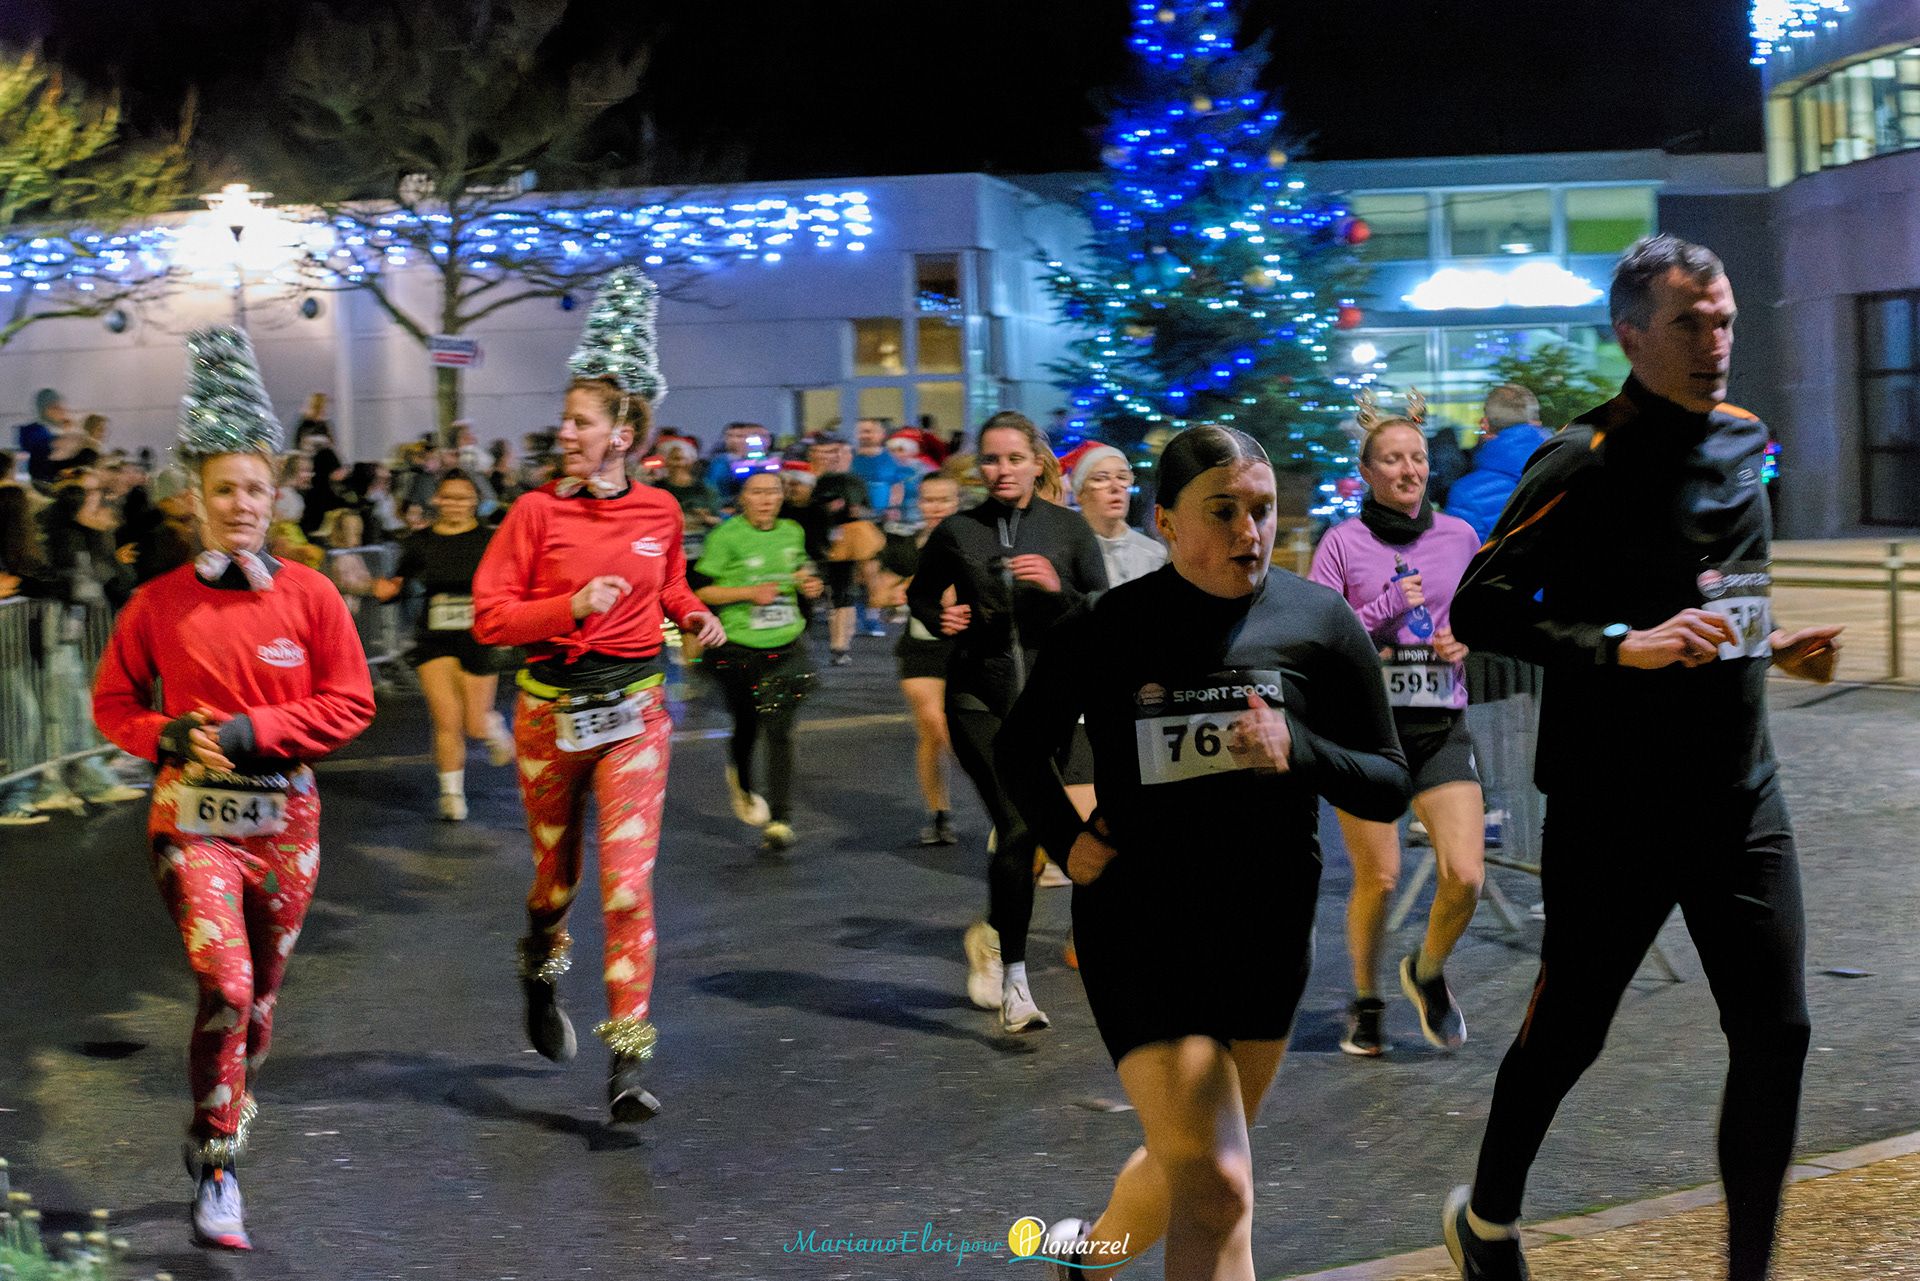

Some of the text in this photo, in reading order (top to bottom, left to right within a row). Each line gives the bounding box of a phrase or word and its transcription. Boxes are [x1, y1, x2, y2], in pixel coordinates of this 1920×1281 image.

[1390, 671, 1439, 693] 595
[1173, 686, 1229, 702] SPORT
[1232, 683, 1279, 699] 2000
